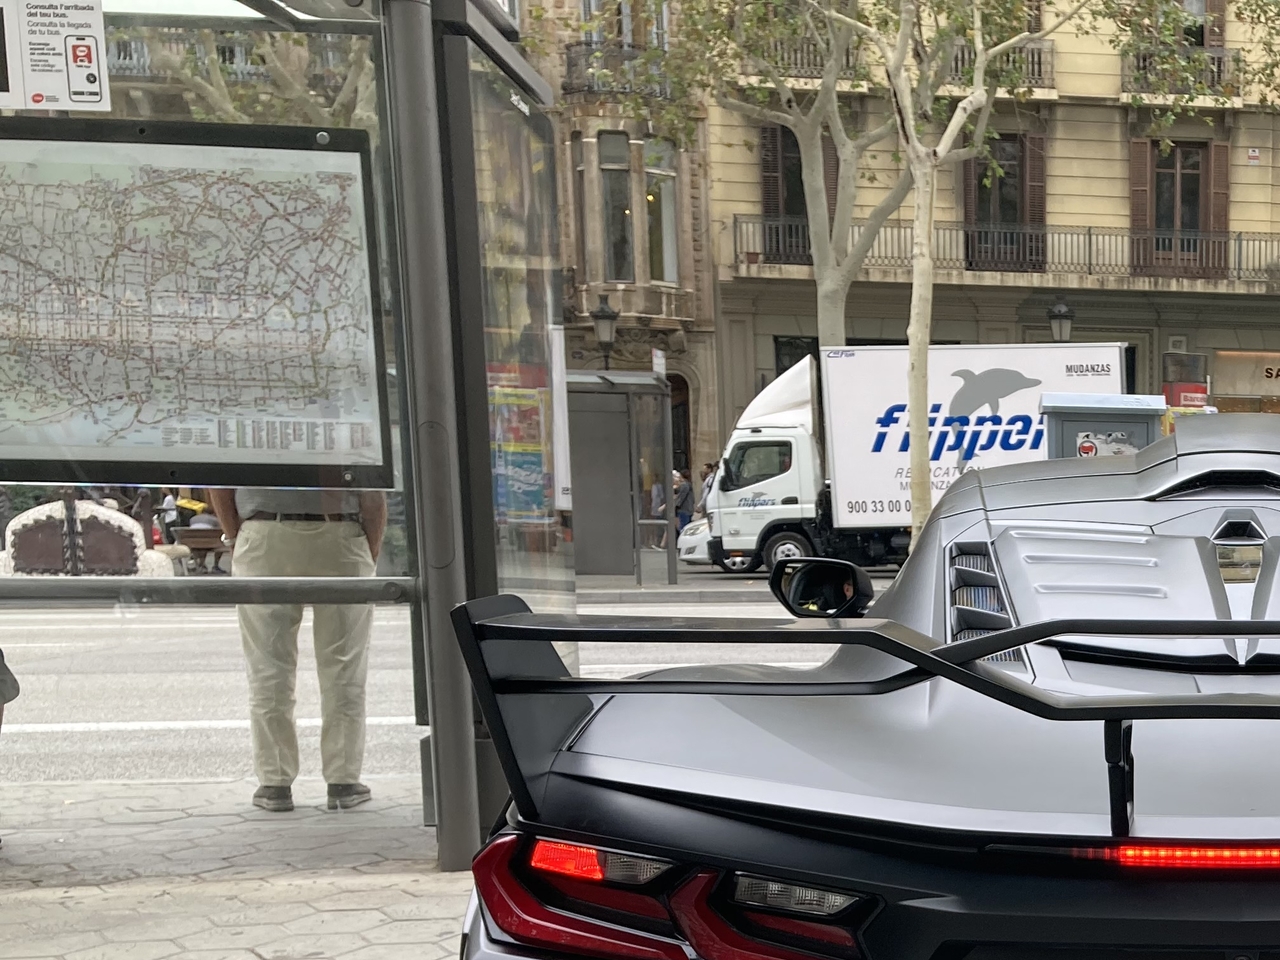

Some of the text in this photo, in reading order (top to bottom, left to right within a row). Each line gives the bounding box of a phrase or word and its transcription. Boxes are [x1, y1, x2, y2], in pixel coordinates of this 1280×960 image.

[27, 20, 58, 28] Consulta
[1066, 364, 1111, 373] MUDANZAS
[894, 466, 985, 478] RECATI
[738, 498, 776, 507] flippers
[847, 501, 867, 513] 900
[871, 500, 884, 512] 33
[888, 500, 901, 512] 00
